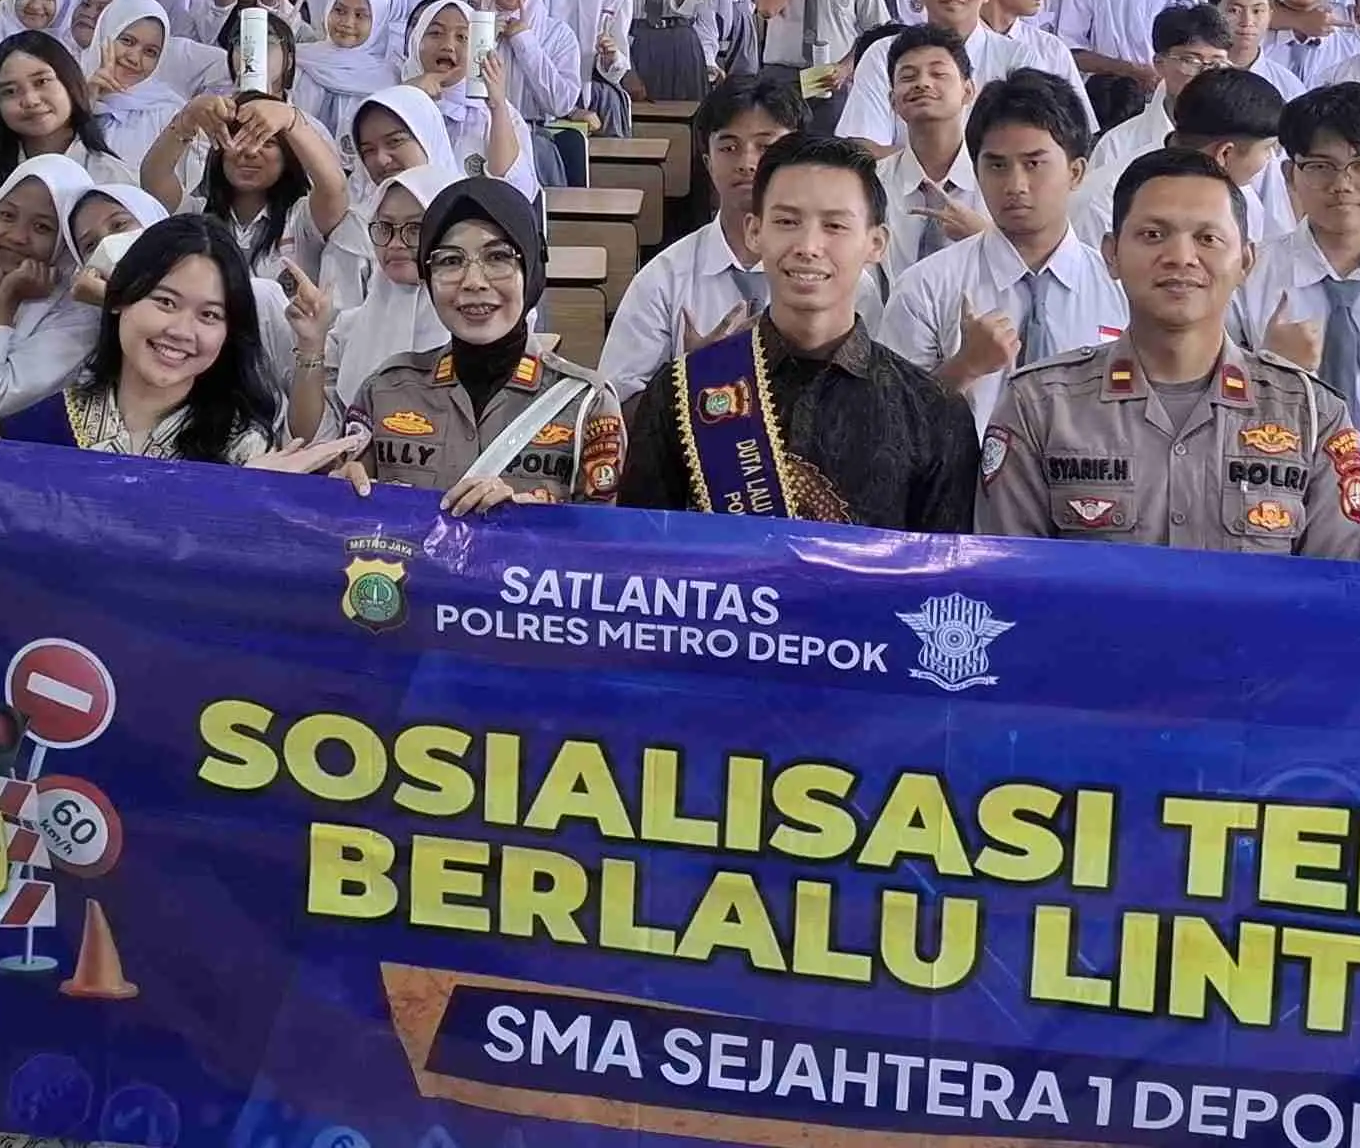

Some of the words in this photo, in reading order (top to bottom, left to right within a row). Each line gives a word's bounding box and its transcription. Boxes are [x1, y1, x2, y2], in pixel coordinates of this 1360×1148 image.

[736, 438, 764, 477] DUTA
[1228, 461, 1308, 490] POLRI
[746, 477, 775, 513] LALU
[350, 539, 387, 549] METRO
[388, 541, 413, 556] JAYA
[499, 565, 780, 626] SATLANTAS
[437, 604, 589, 647] POLRES
[597, 620, 740, 659] METRO
[747, 634, 889, 674] DEPOK
[195, 698, 1116, 890] SOSIALISASI
[53, 799, 97, 844] 60
[305, 822, 979, 990] BERLALU
[483, 1005, 646, 1082] SMA
[659, 1028, 1070, 1123] SEJAHTERA
[1087, 1075, 1113, 1127] 1
